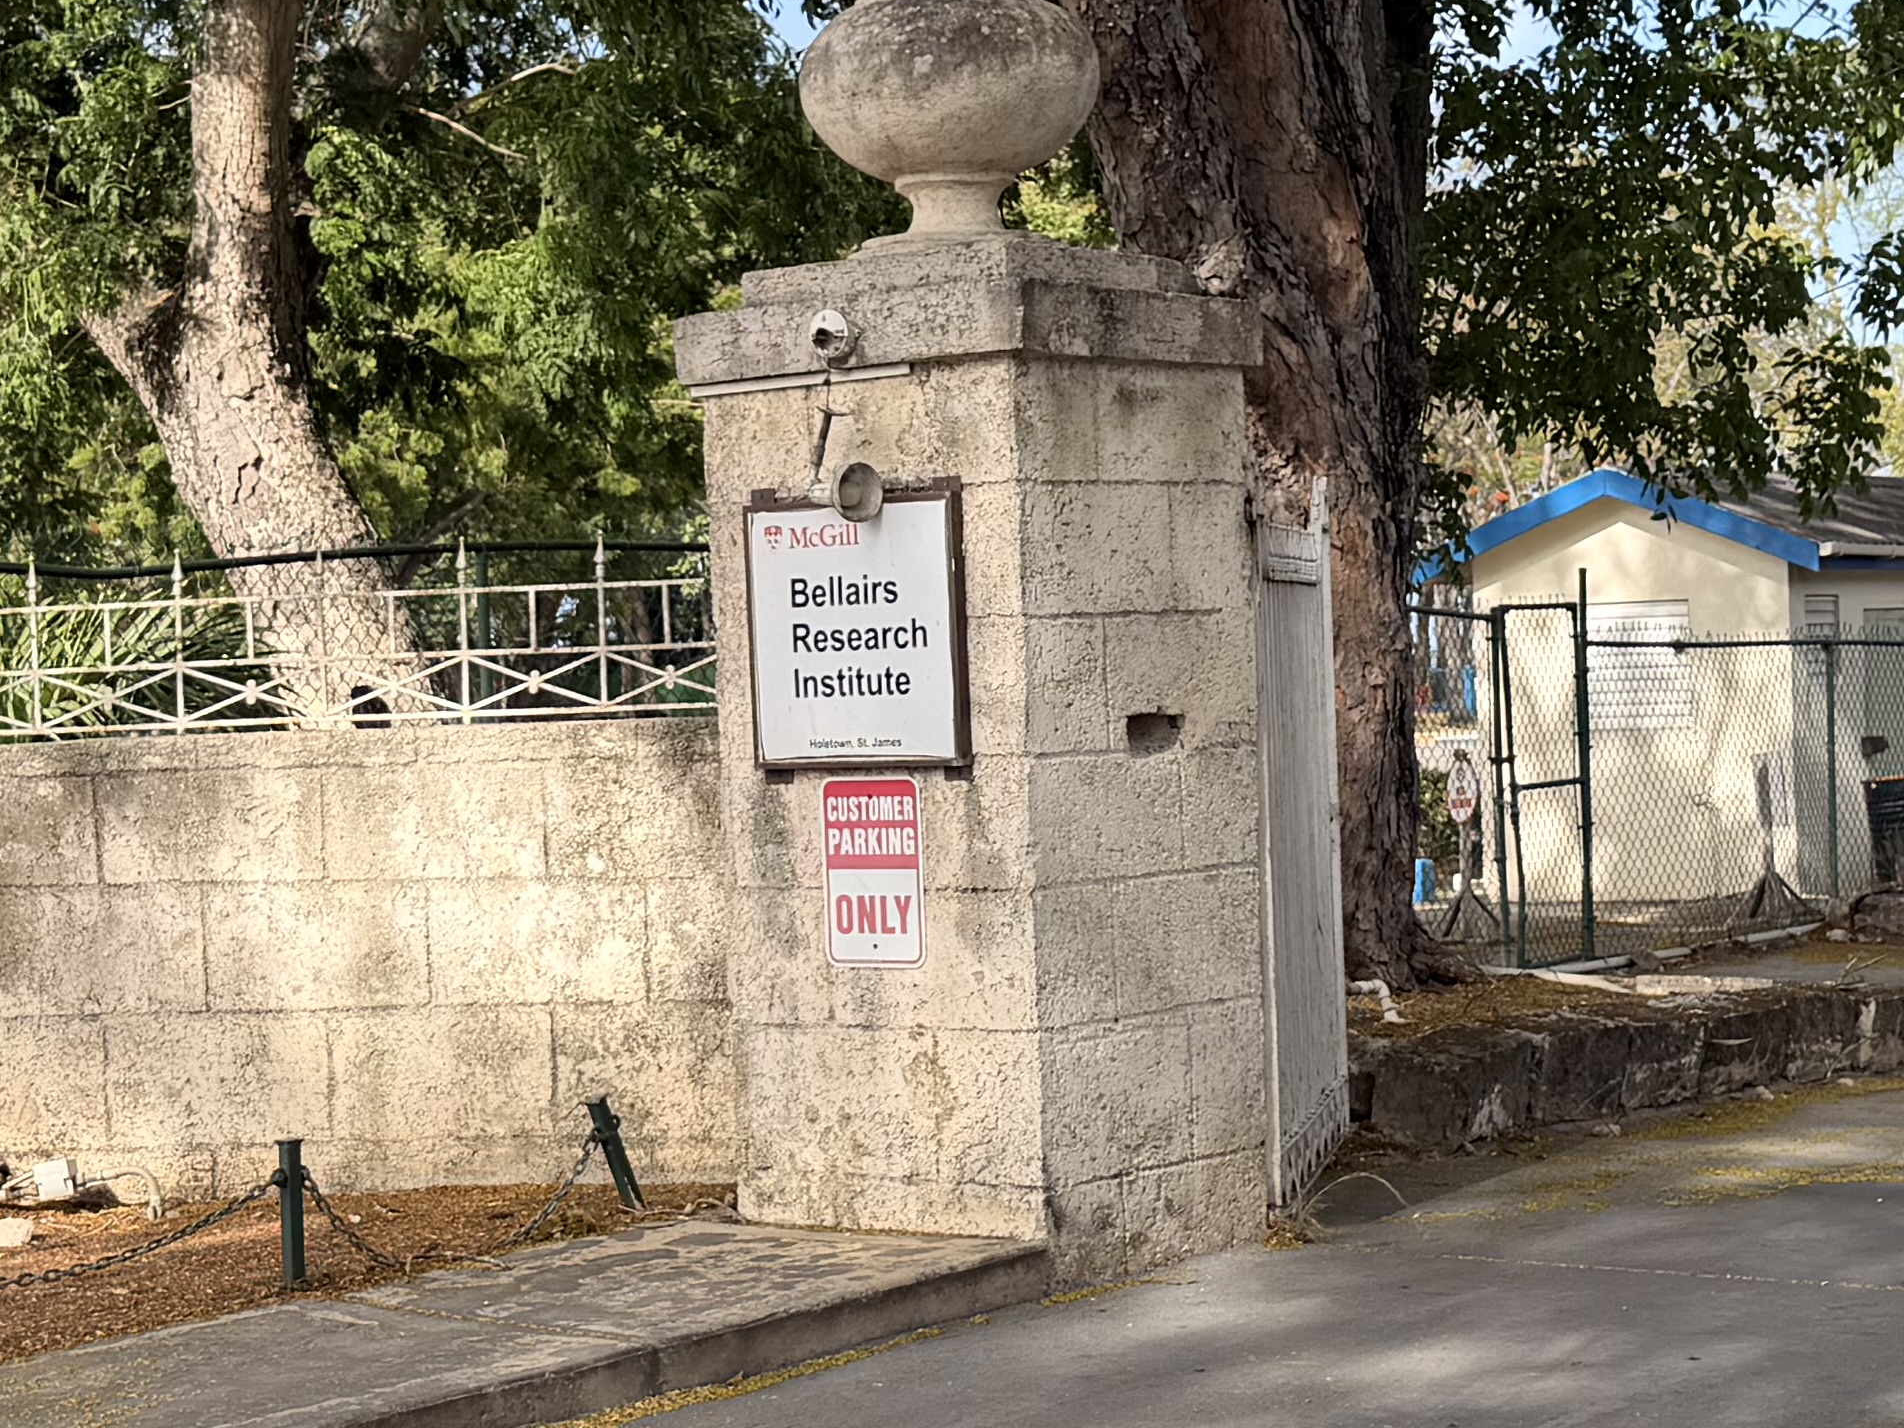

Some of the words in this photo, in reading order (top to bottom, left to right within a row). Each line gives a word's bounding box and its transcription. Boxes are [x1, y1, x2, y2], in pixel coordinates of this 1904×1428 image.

[788, 524, 859, 549] McGill
[790, 574, 898, 608] Bellairs
[792, 618, 927, 653] Research
[794, 666, 910, 698] Institute
[826, 795, 914, 822] CUSTOMER
[827, 827, 916, 855] PARKING
[835, 894, 912, 935] ONLY
